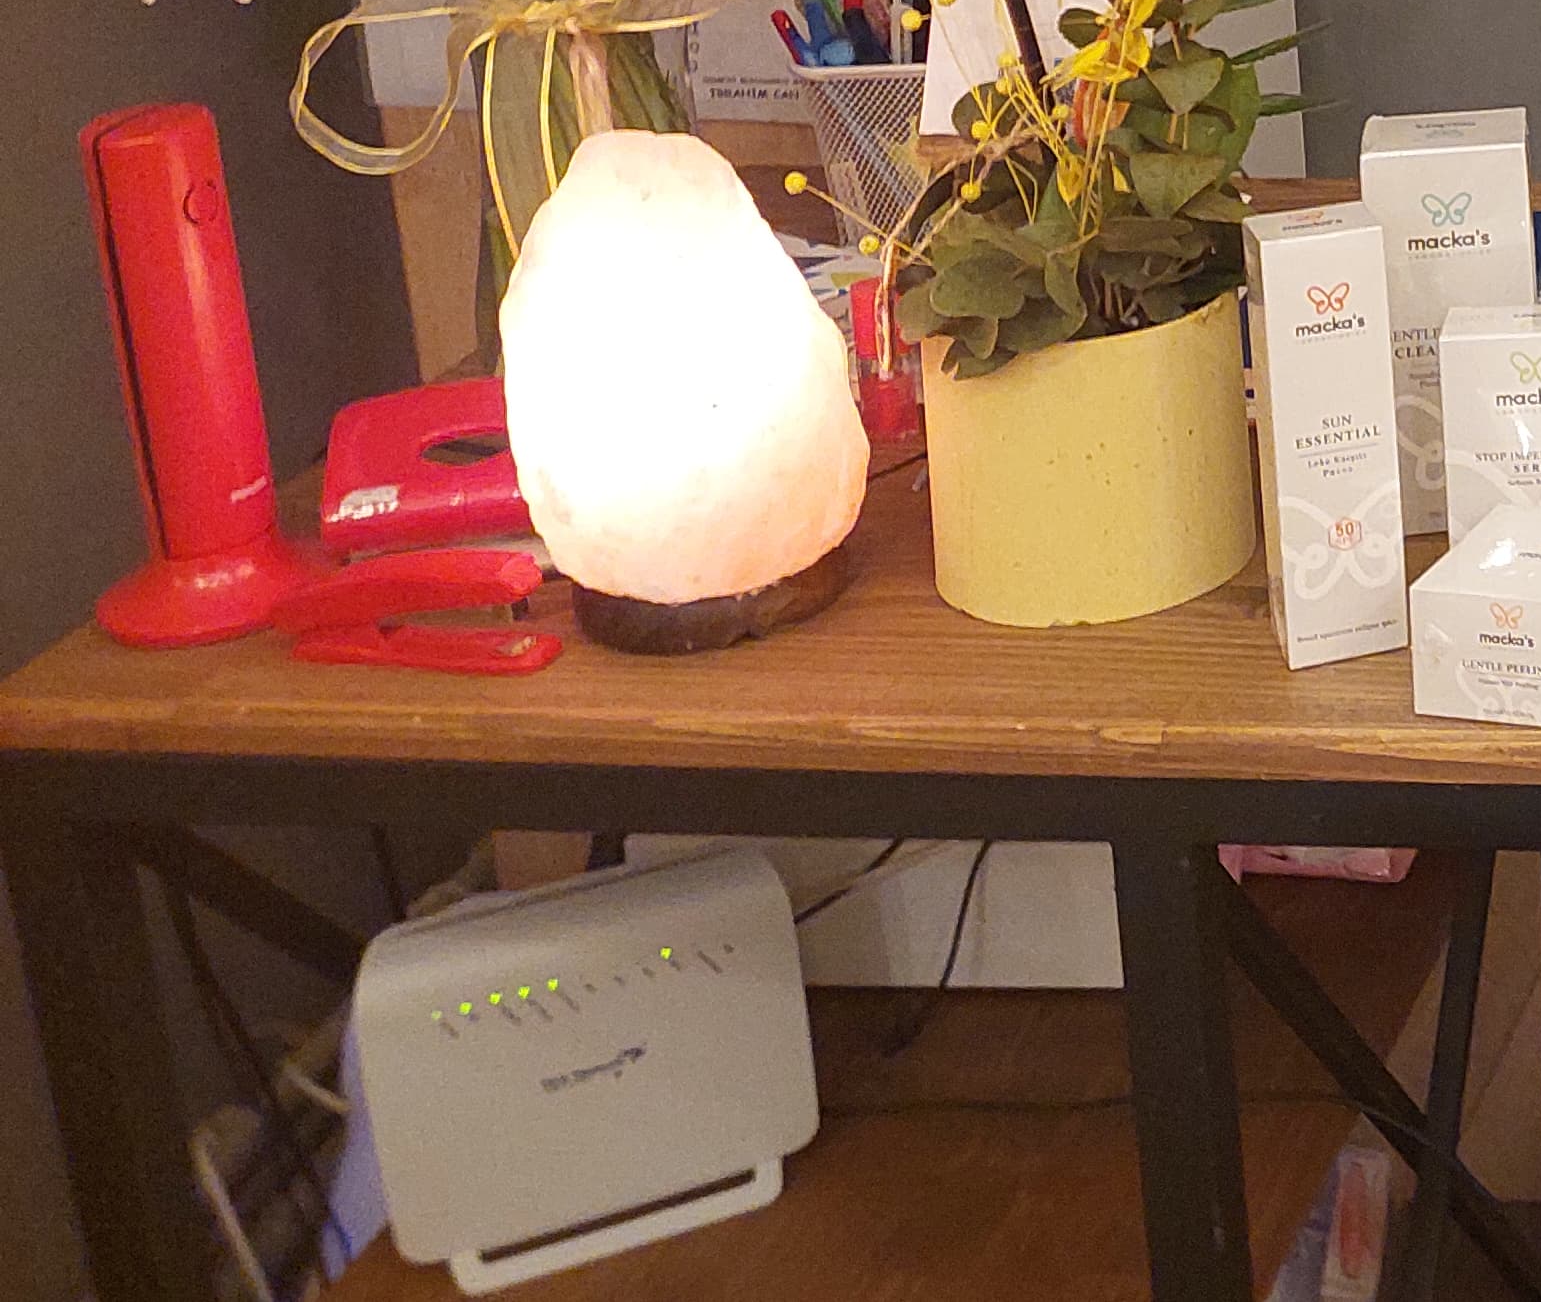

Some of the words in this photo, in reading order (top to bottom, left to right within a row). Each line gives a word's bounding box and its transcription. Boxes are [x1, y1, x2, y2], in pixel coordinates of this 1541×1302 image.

[1408, 228, 1491, 252] macka's
[1295, 312, 1366, 338] macka's
[1321, 413, 1352, 430] SUN
[1294, 425, 1382, 450] ESSENTIAL
[1474, 450, 1508, 463] STOP
[1335, 520, 1355, 538] 50
[1478, 631, 1535, 649] macka's
[1462, 658, 1506, 673] GENTLE
